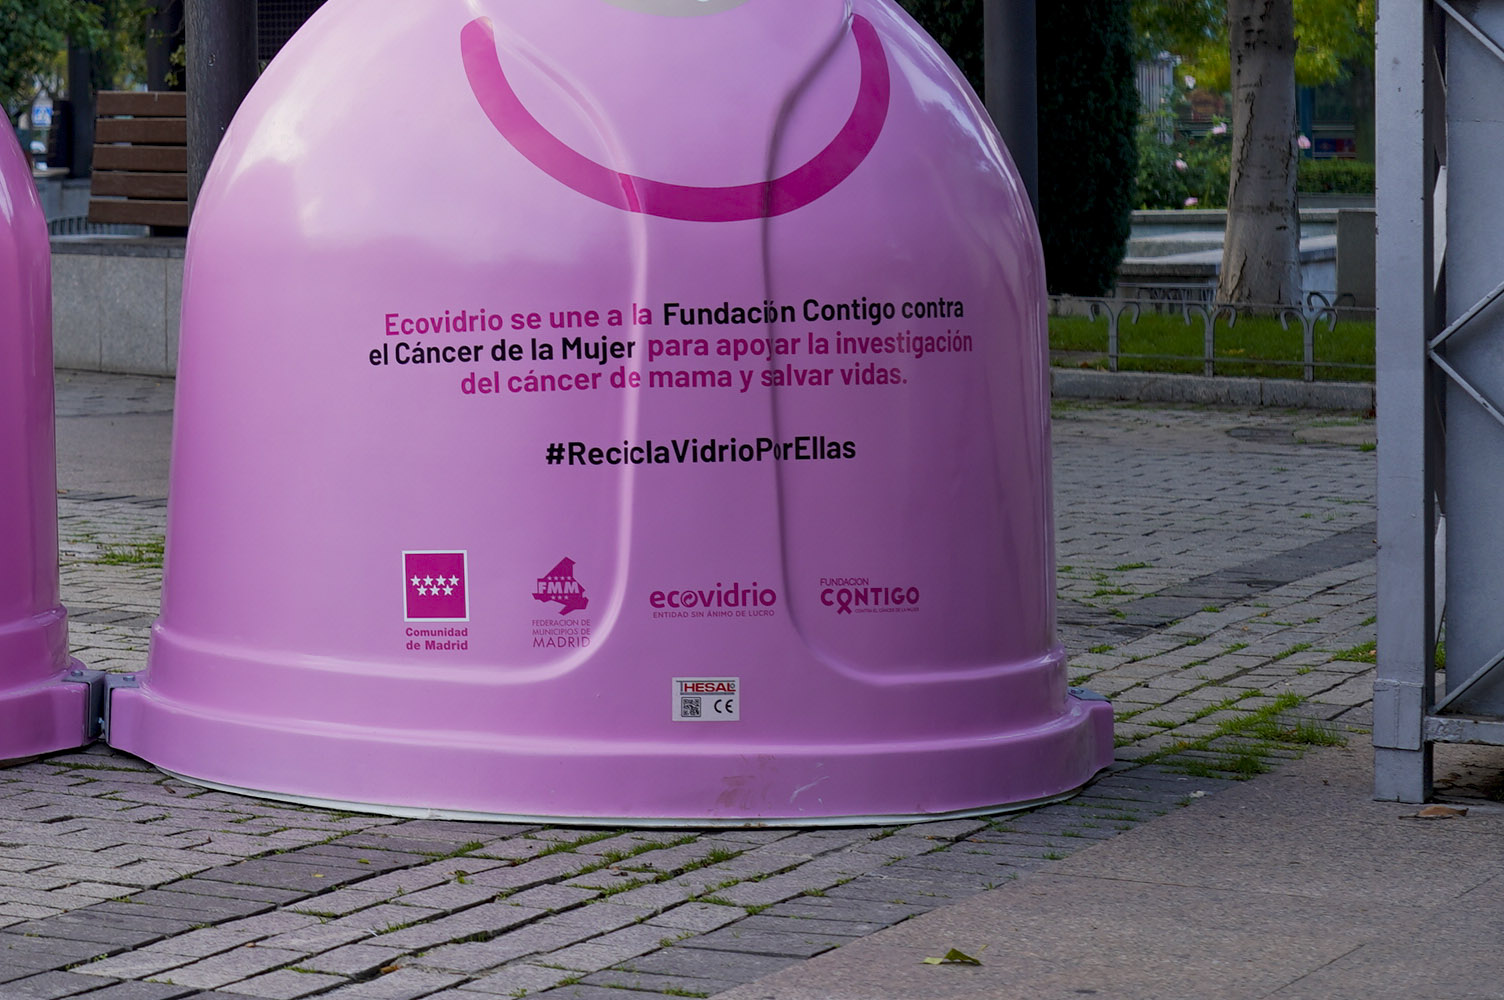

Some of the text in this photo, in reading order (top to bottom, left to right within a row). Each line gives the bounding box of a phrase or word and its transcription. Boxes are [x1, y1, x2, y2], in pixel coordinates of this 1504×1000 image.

[384, 296, 965, 336] Ecovidrio se une a la Fundación Contigo contra
[368, 329, 973, 366] el Cáncer de la Mujer para apoyar la investigación
[460, 361, 908, 395] del cáncer de mama y salvar vidas.
[545, 435, 857, 466] #ReciclaVidrioPorEllas
[538, 581, 581, 594] FMM
[649, 581, 777, 608] ecovidrio
[820, 586, 920, 615] CONTIGO
[652, 611, 689, 619] ENTIDAD
[748, 609, 775, 617] LUCRO
[405, 627, 468, 637] Comunidad
[580, 627, 591, 635] DE
[406, 640, 468, 650] de Madrid
[532, 636, 591, 648] MADRID
